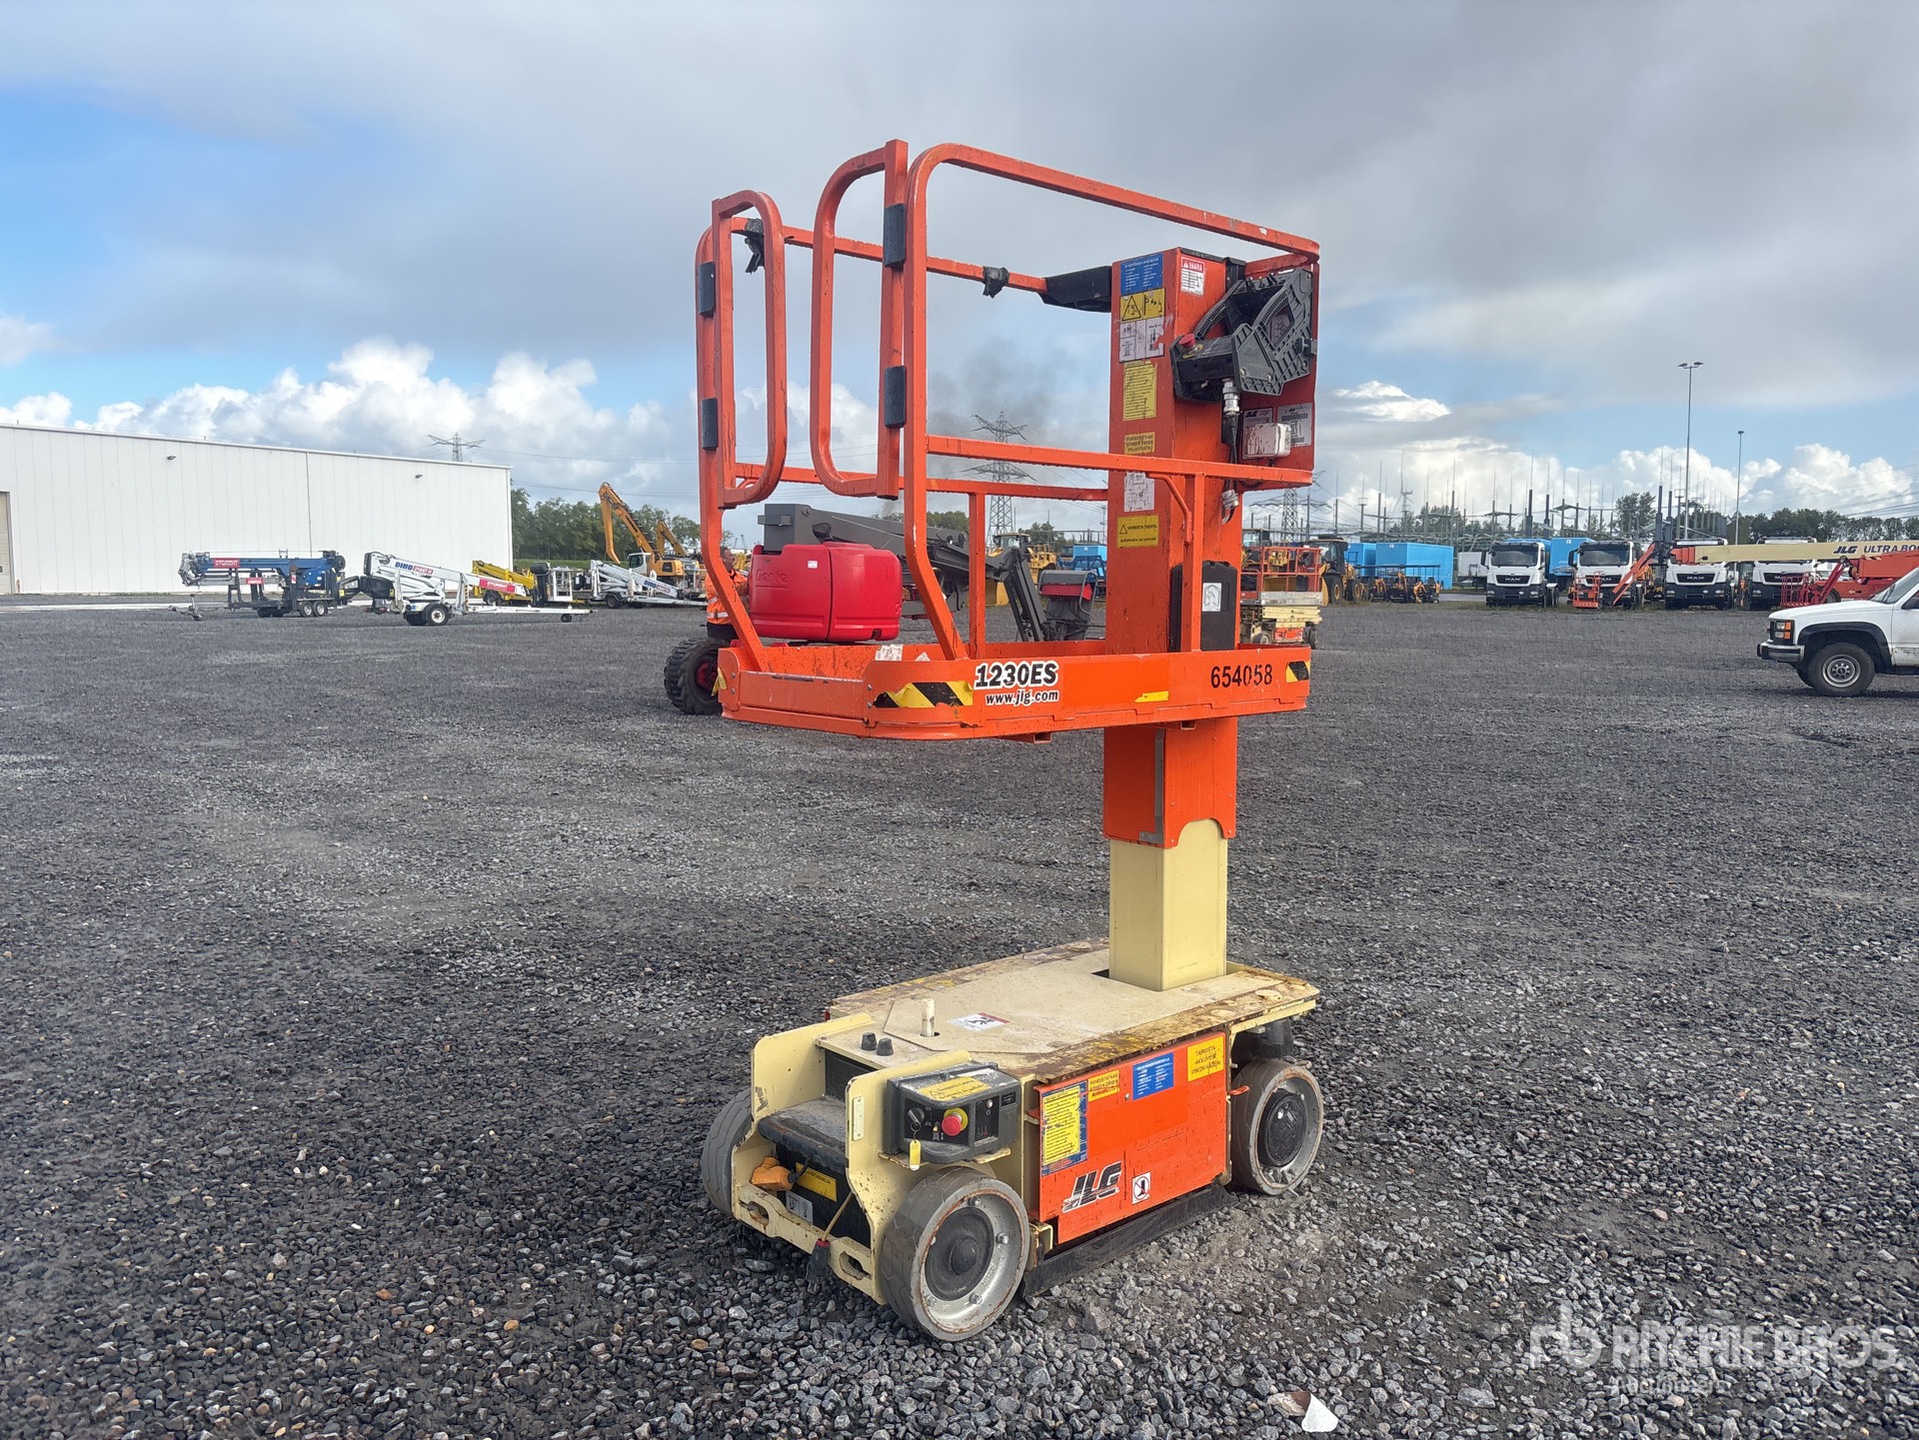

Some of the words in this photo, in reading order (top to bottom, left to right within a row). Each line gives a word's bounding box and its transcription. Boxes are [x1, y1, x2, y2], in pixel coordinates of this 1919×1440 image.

[1833, 545, 1858, 554] JLG
[1863, 545, 1898, 553] ULTRA
[394, 561, 413, 571] DINO
[975, 662, 1058, 689] 1230ES
[1210, 663, 1273, 689] 654058
[986, 690, 1059, 706] www.jlg.com
[1062, 1161, 1122, 1213] JLG
